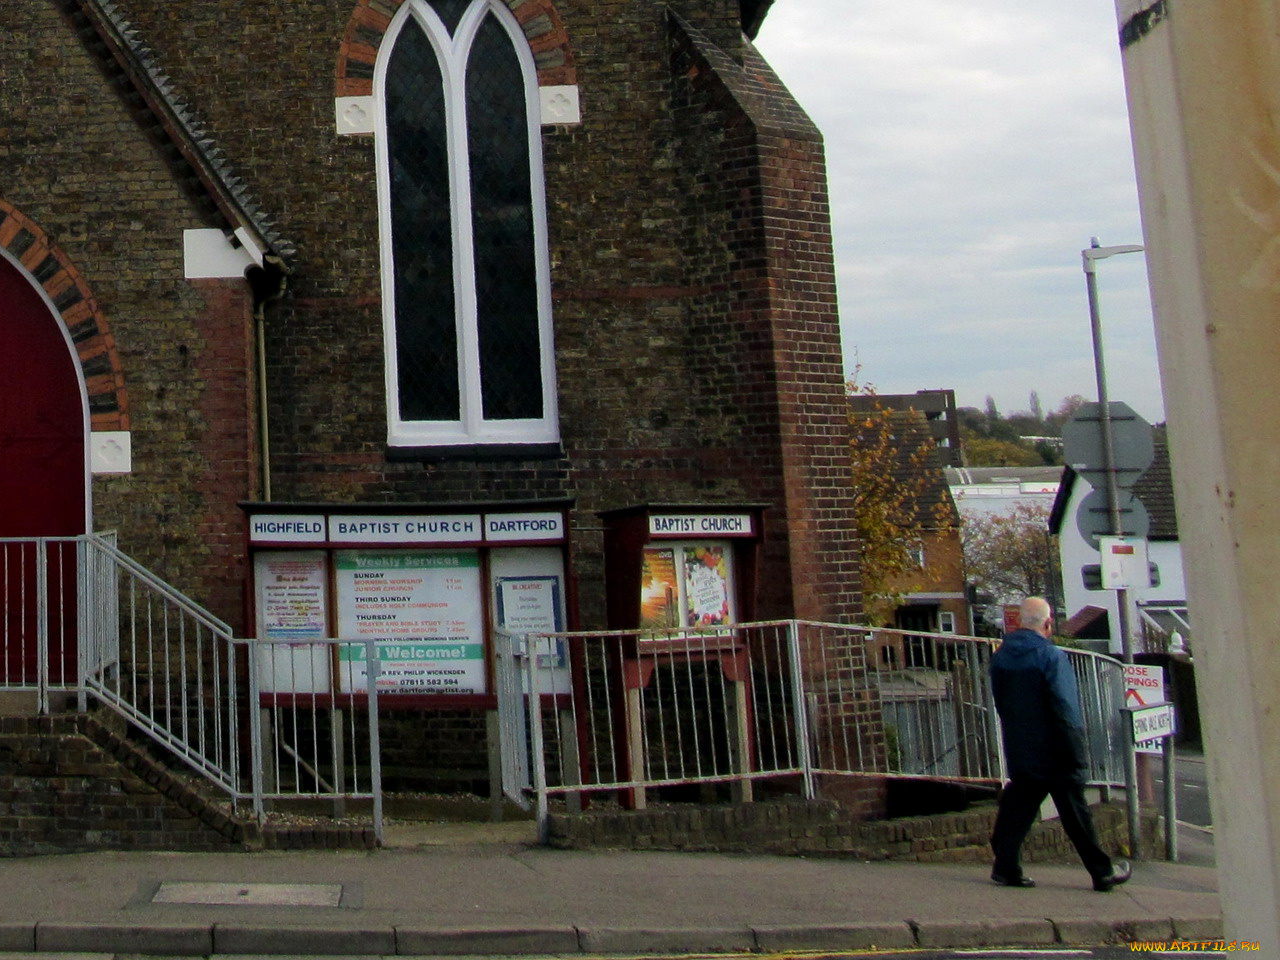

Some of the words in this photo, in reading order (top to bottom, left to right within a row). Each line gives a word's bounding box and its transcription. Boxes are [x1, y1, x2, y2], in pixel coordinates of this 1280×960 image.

[254, 522, 322, 533] HIGHFIELD
[338, 522, 400, 533] BAPTIST
[405, 522, 473, 533] CHURCH
[490, 519, 557, 532] DARTFORD
[654, 518, 696, 531] BAPTIST
[701, 518, 742, 530] CHURCH
[355, 557, 400, 567] Weekly
[404, 556, 459, 566] Services
[359, 646, 380, 658] Al
[385, 645, 466, 659] Welcome!
